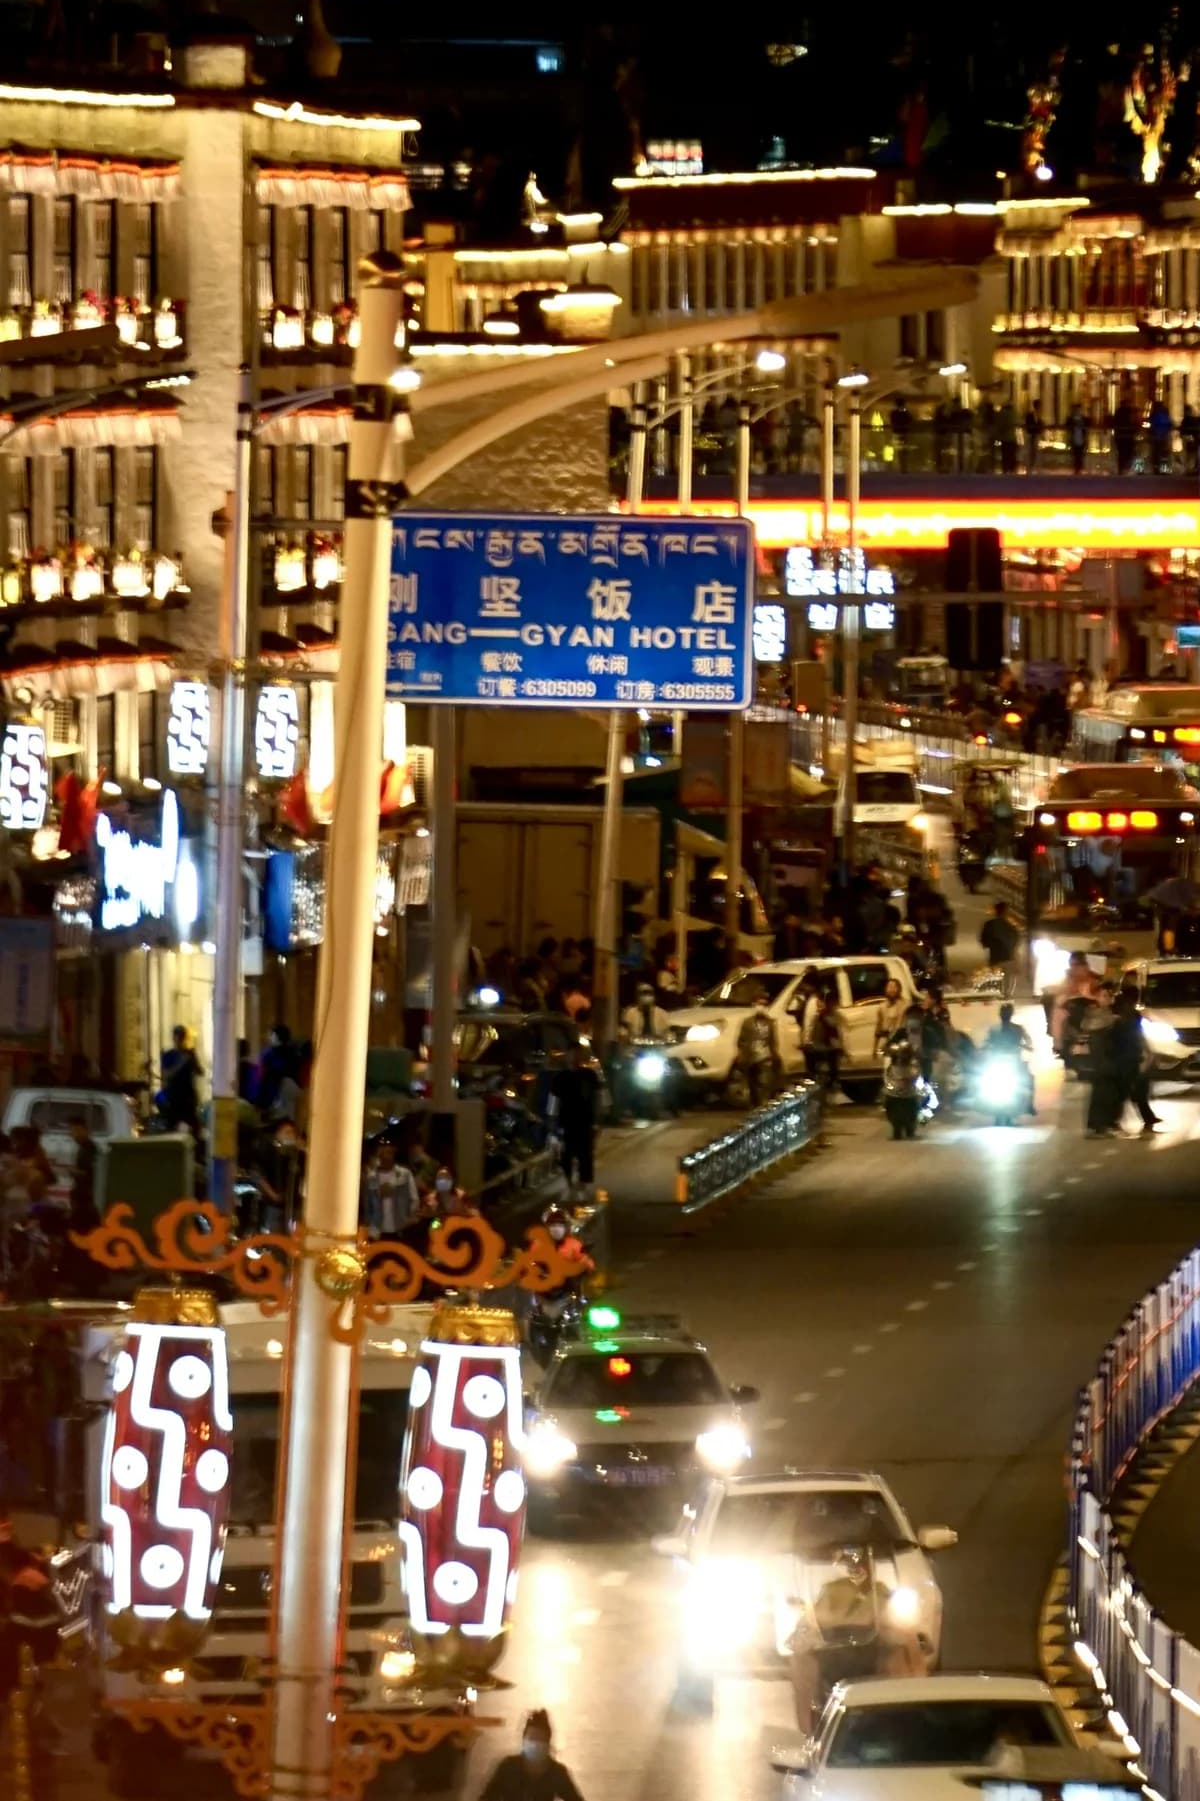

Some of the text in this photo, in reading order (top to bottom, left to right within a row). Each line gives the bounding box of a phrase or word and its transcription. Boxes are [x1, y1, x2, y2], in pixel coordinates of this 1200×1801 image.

[629, 627, 736, 650] HOTEL
[481, 651, 523, 672] 餐饮
[587, 654, 629, 675] 休闲
[692, 656, 735, 677] 观景
